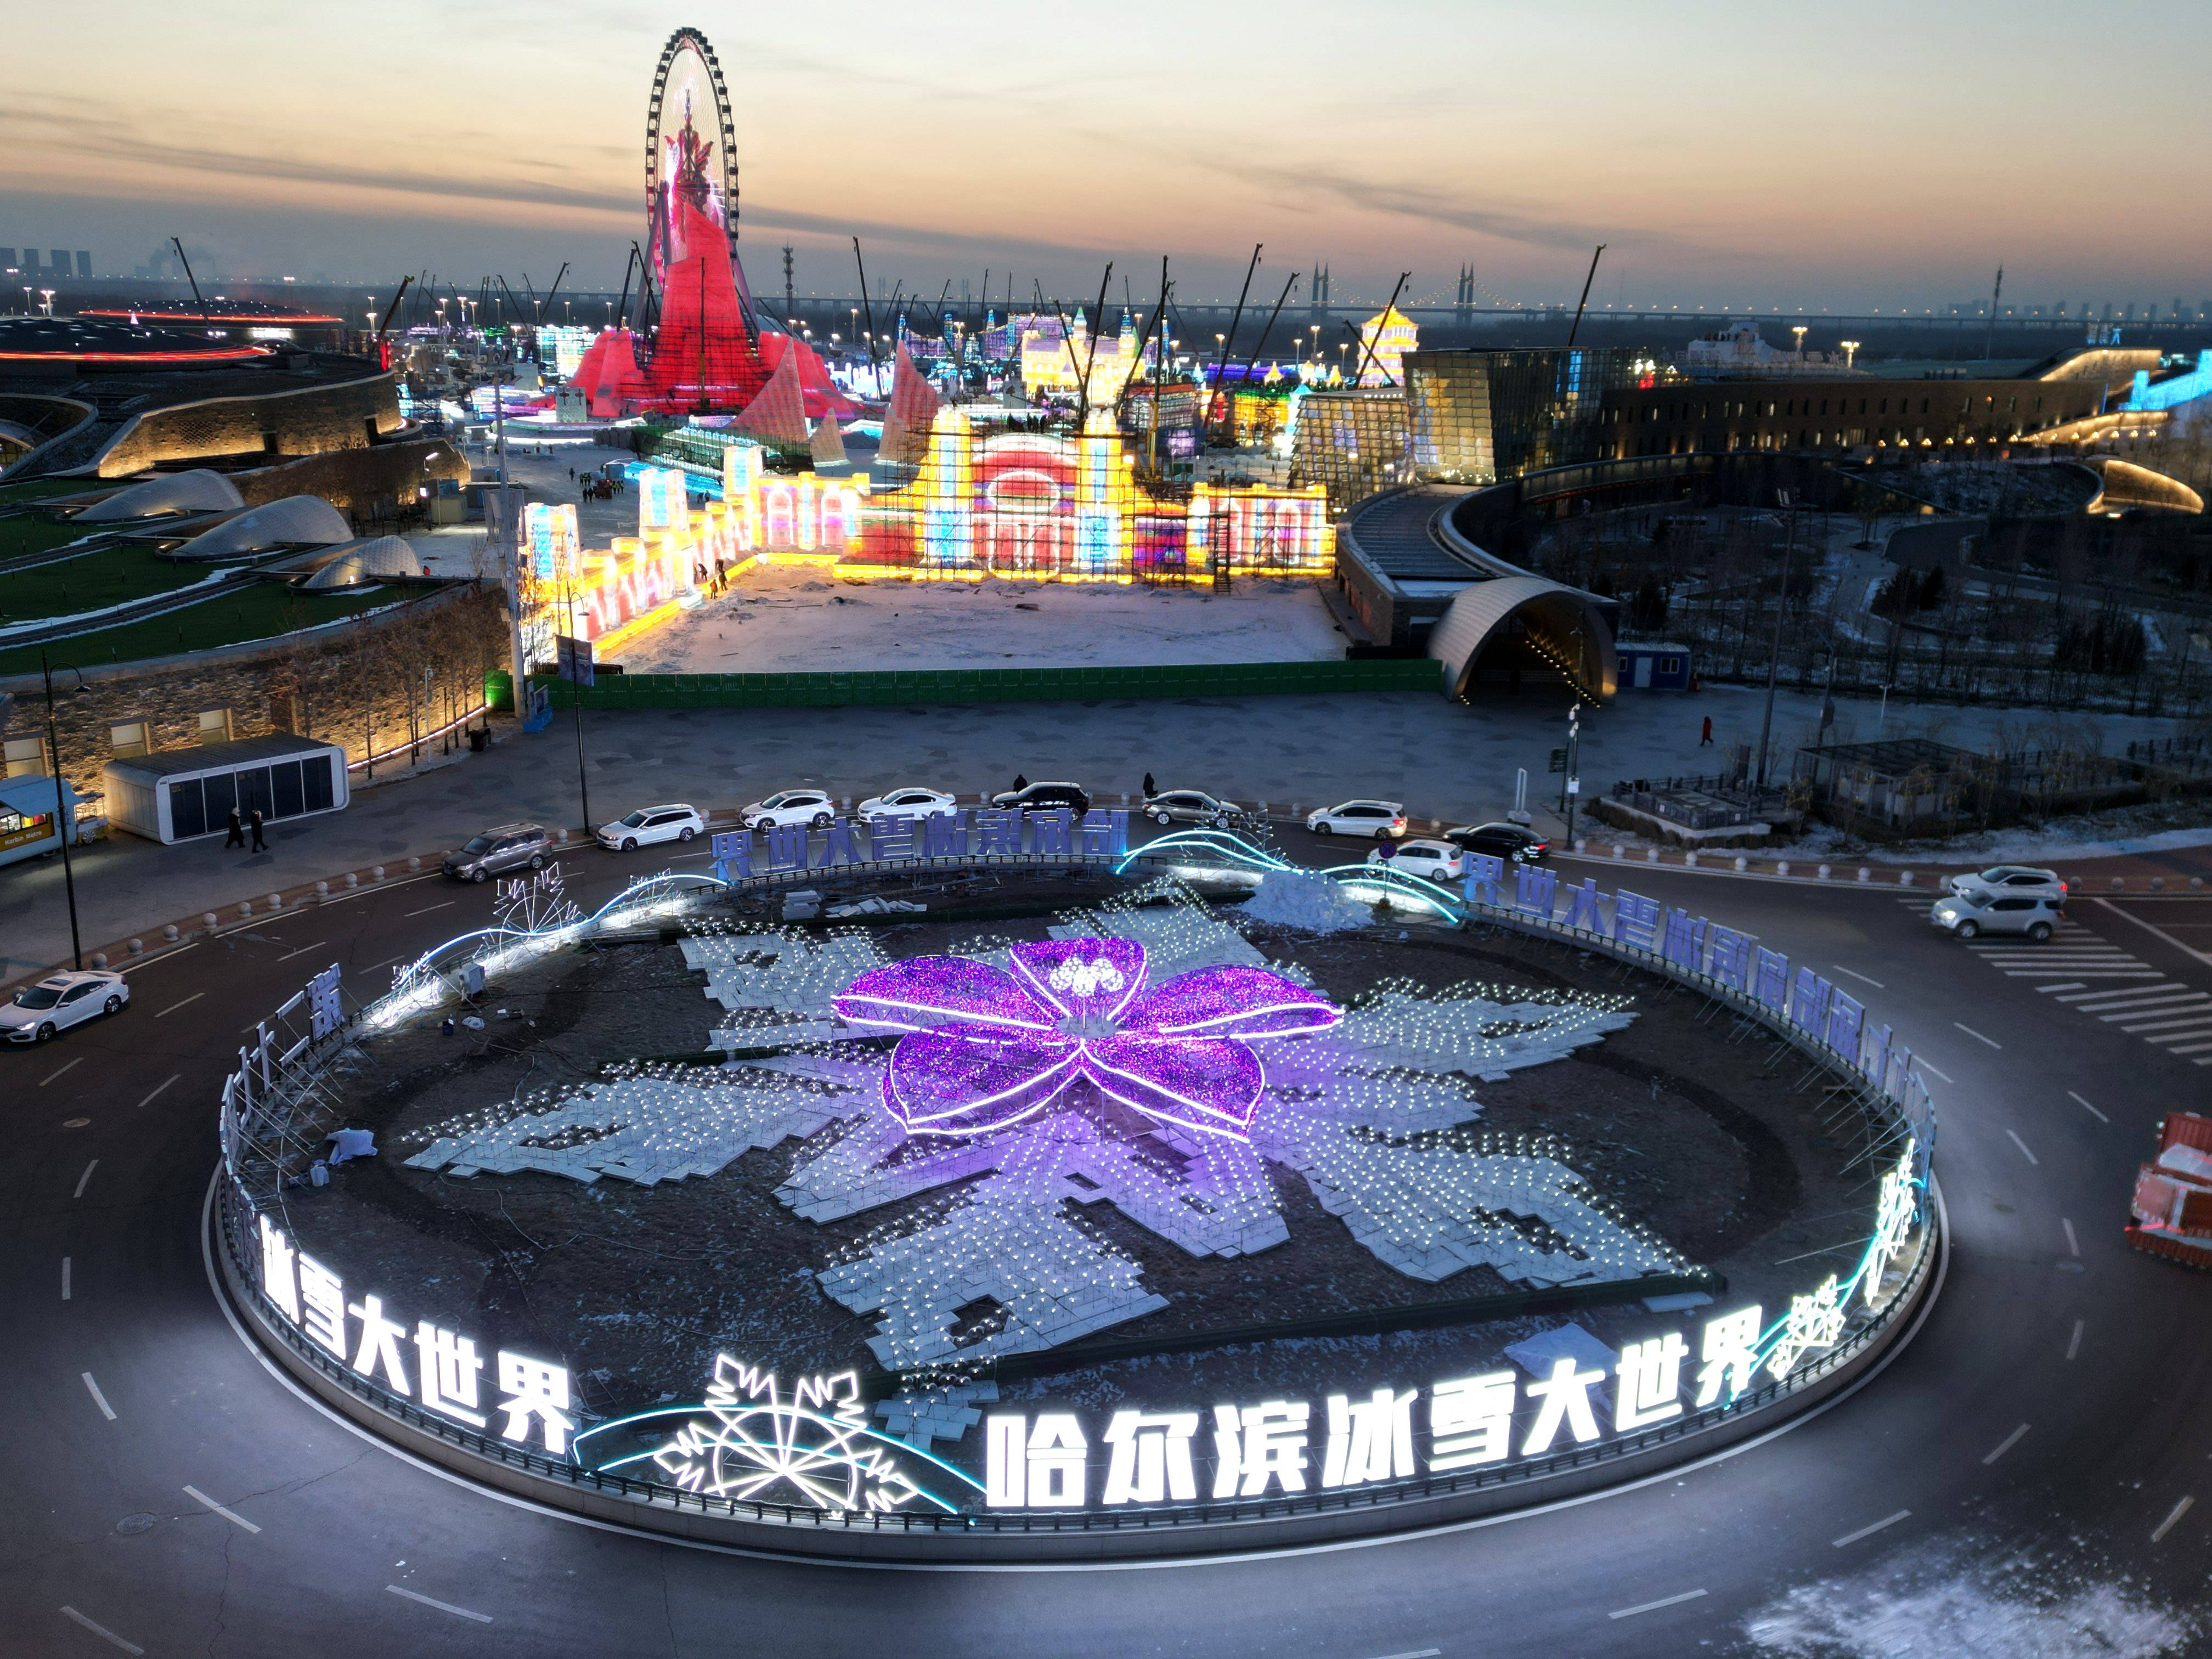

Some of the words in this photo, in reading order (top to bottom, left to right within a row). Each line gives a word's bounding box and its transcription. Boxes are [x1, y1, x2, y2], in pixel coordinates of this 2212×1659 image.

[4, 836, 24, 845] Harbin
[986, 1305, 1762, 1508] 哈尔滨冰雪大世界
